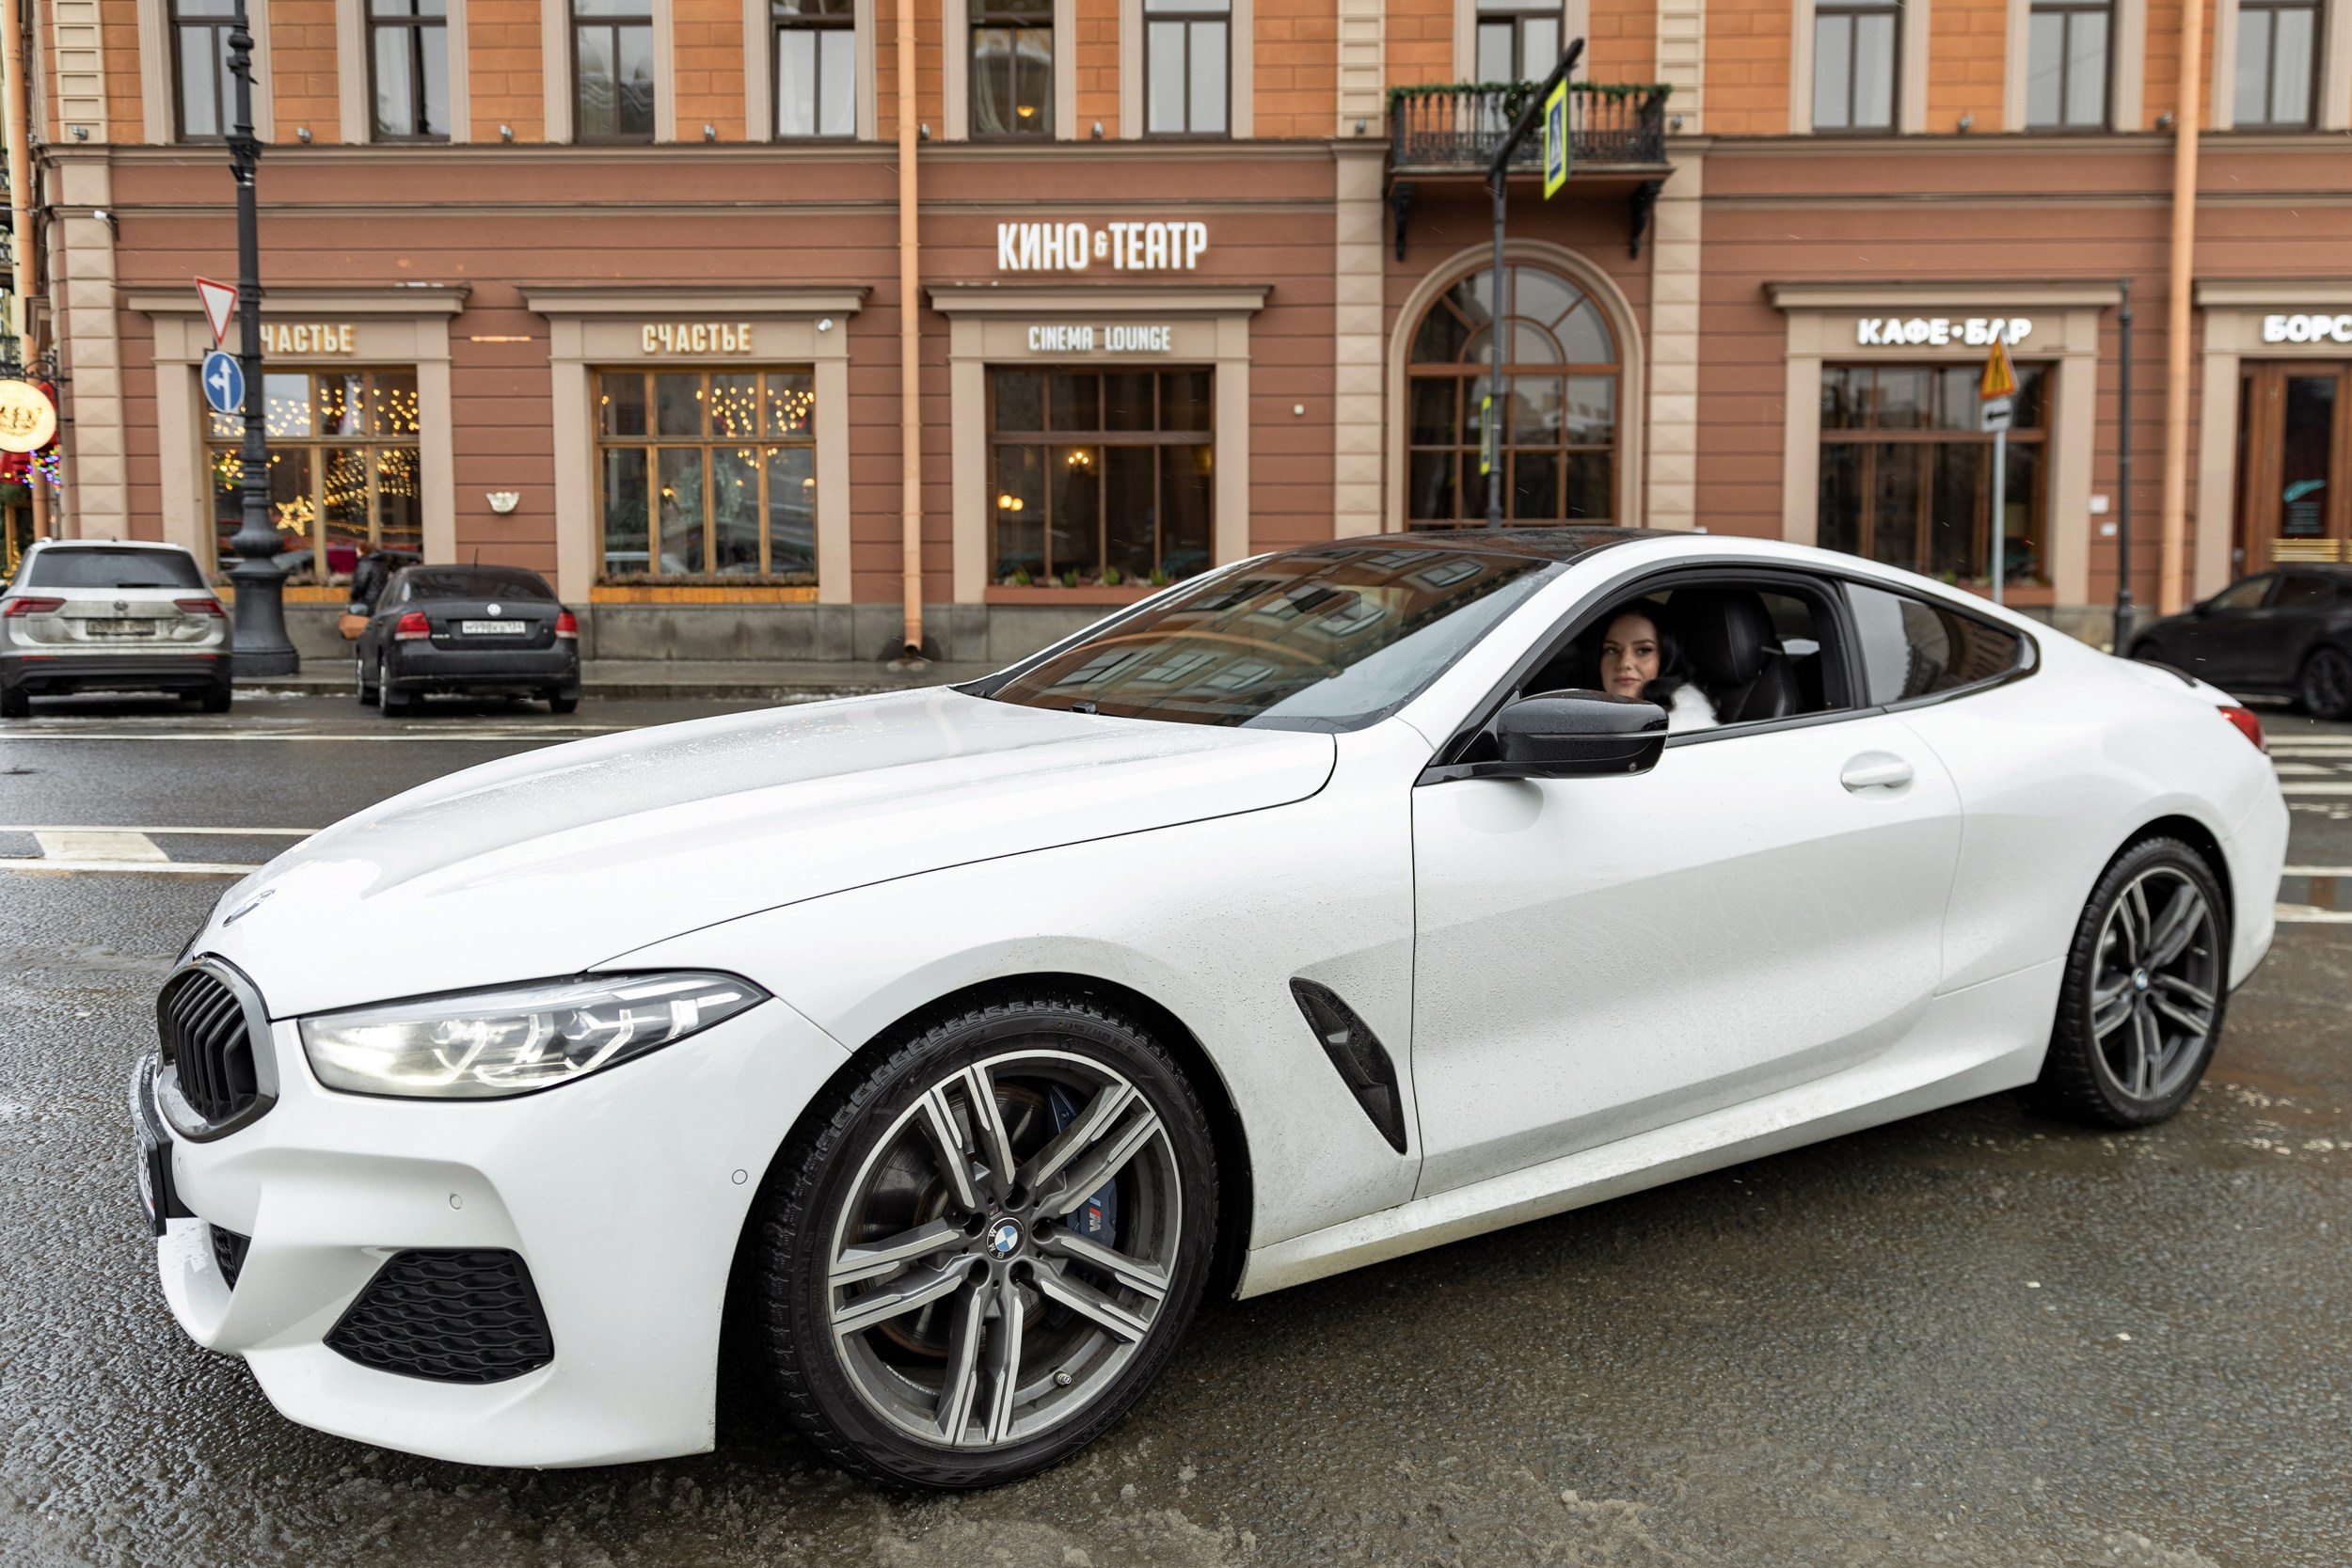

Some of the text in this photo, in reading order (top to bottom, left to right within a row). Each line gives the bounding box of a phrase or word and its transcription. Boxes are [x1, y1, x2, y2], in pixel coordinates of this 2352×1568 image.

[997, 223, 1089, 271] КИНО
[1108, 222, 1208, 270] ТЕАТР
[260, 324, 354, 353] ЧАСТЬЕ
[642, 323, 751, 353] СЧАСТЬЕ
[1027, 325, 1171, 351] CINEMA LOUNGE
